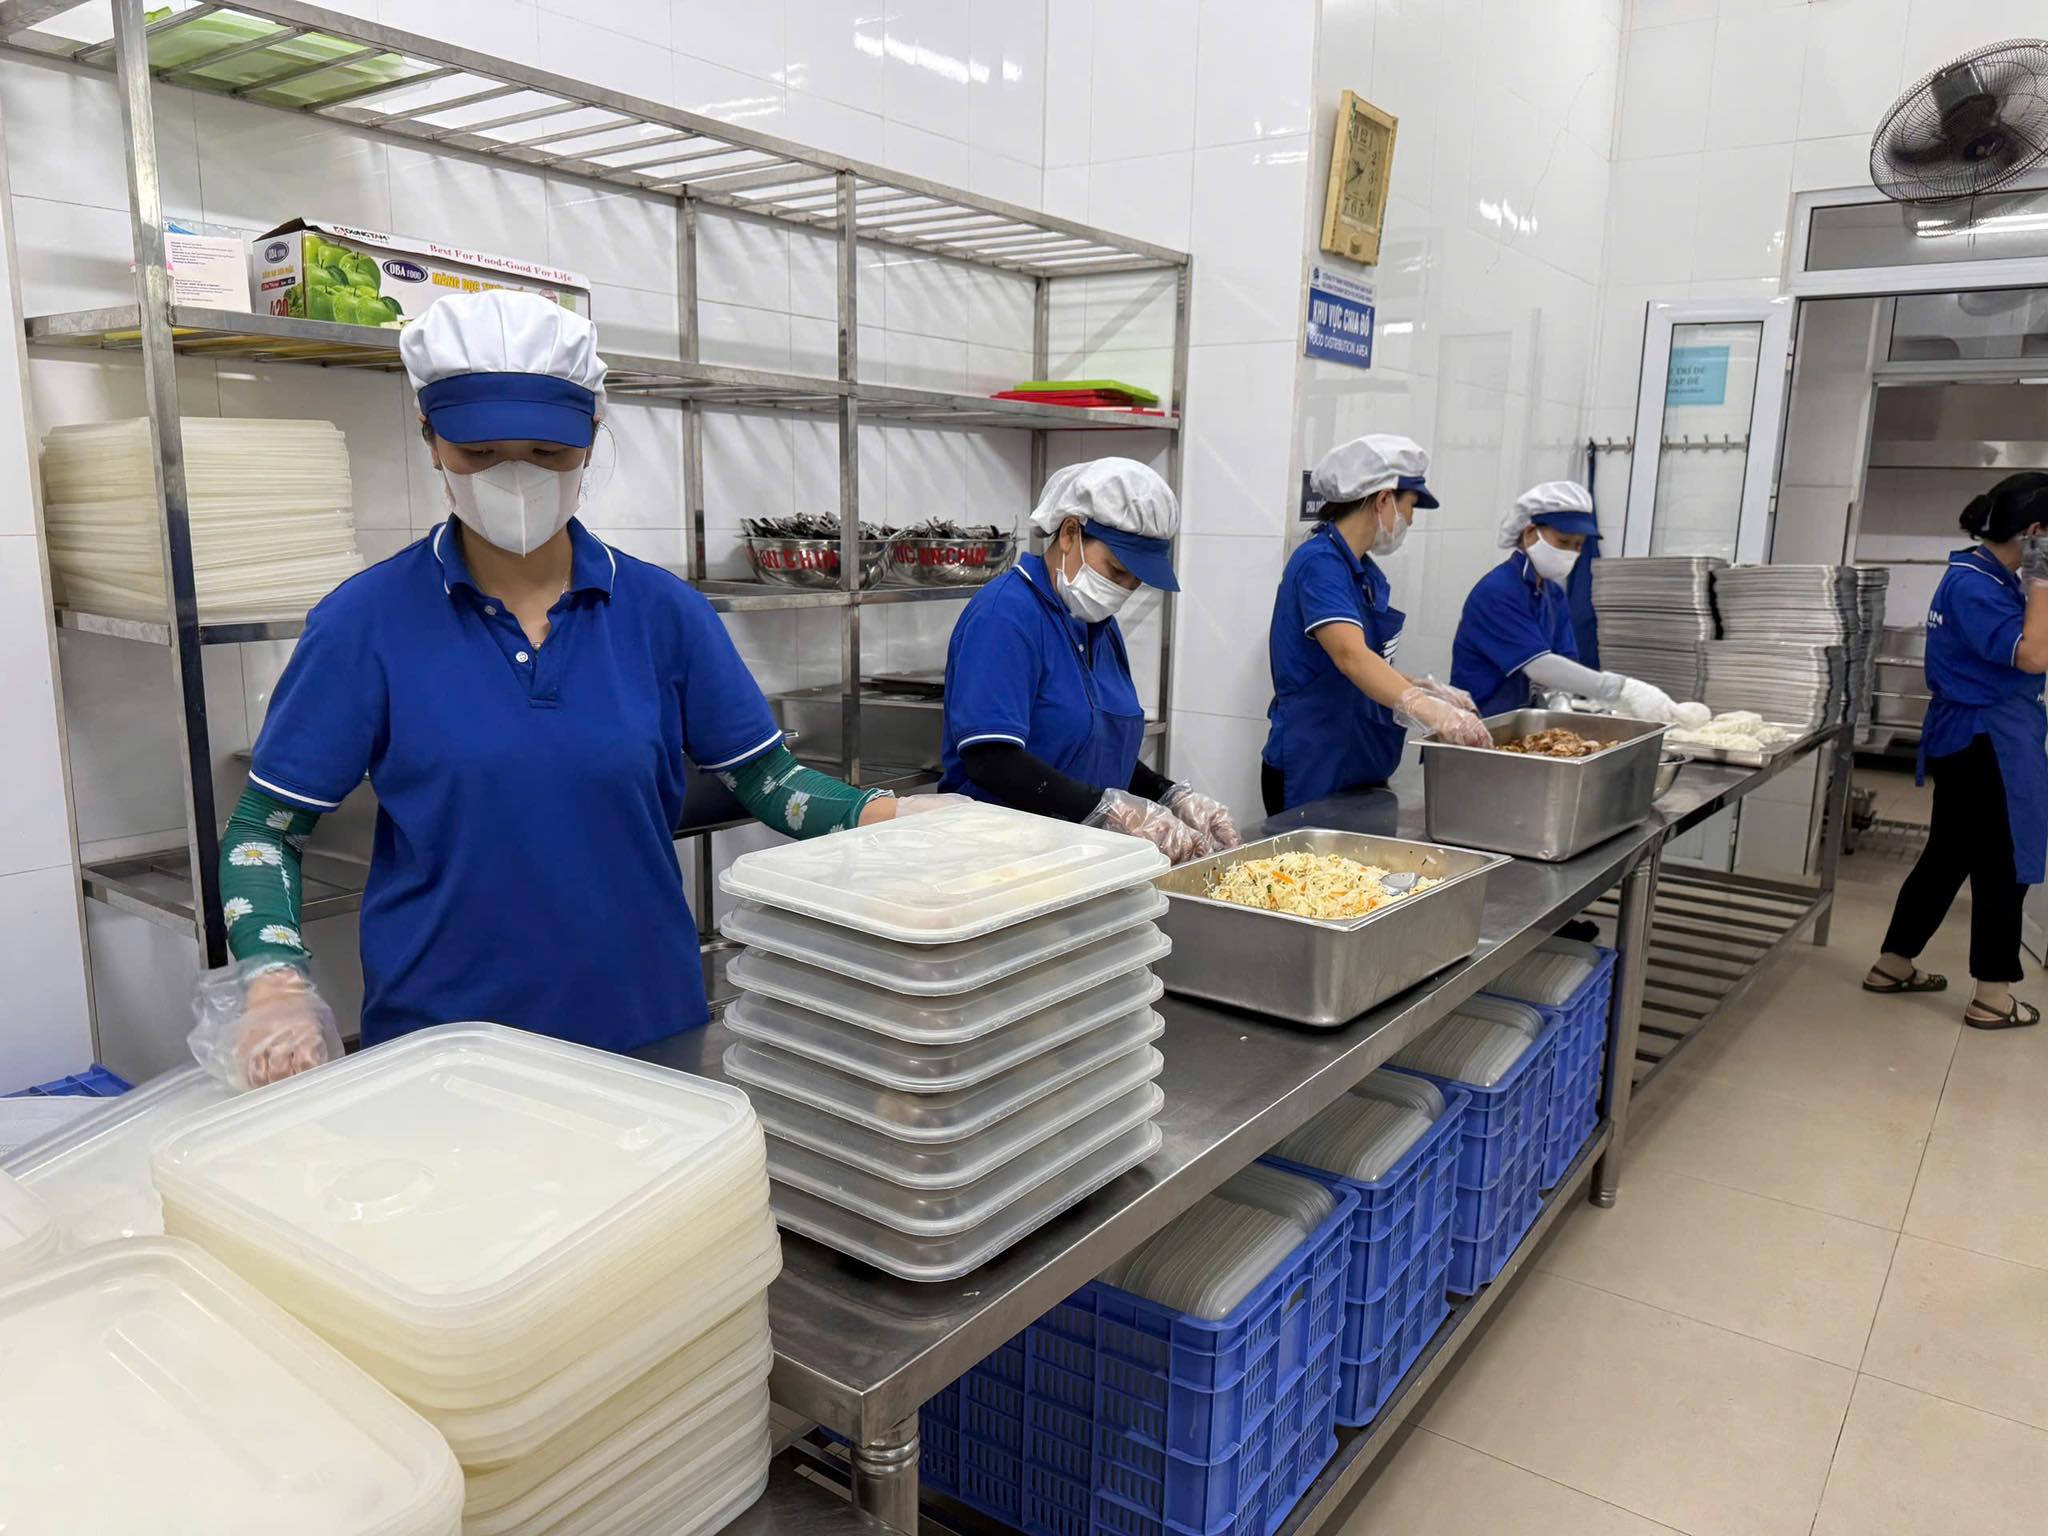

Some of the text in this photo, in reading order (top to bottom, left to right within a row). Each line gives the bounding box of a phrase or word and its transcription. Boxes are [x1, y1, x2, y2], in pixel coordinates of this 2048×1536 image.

[389, 263, 406, 277] OBA
[429, 244, 573, 283] Best For Food-Good For Life
[1312, 299, 1328, 326] KHU
[1328, 303, 1343, 333] VỰC
[1343, 308, 1360, 335] CHIA
